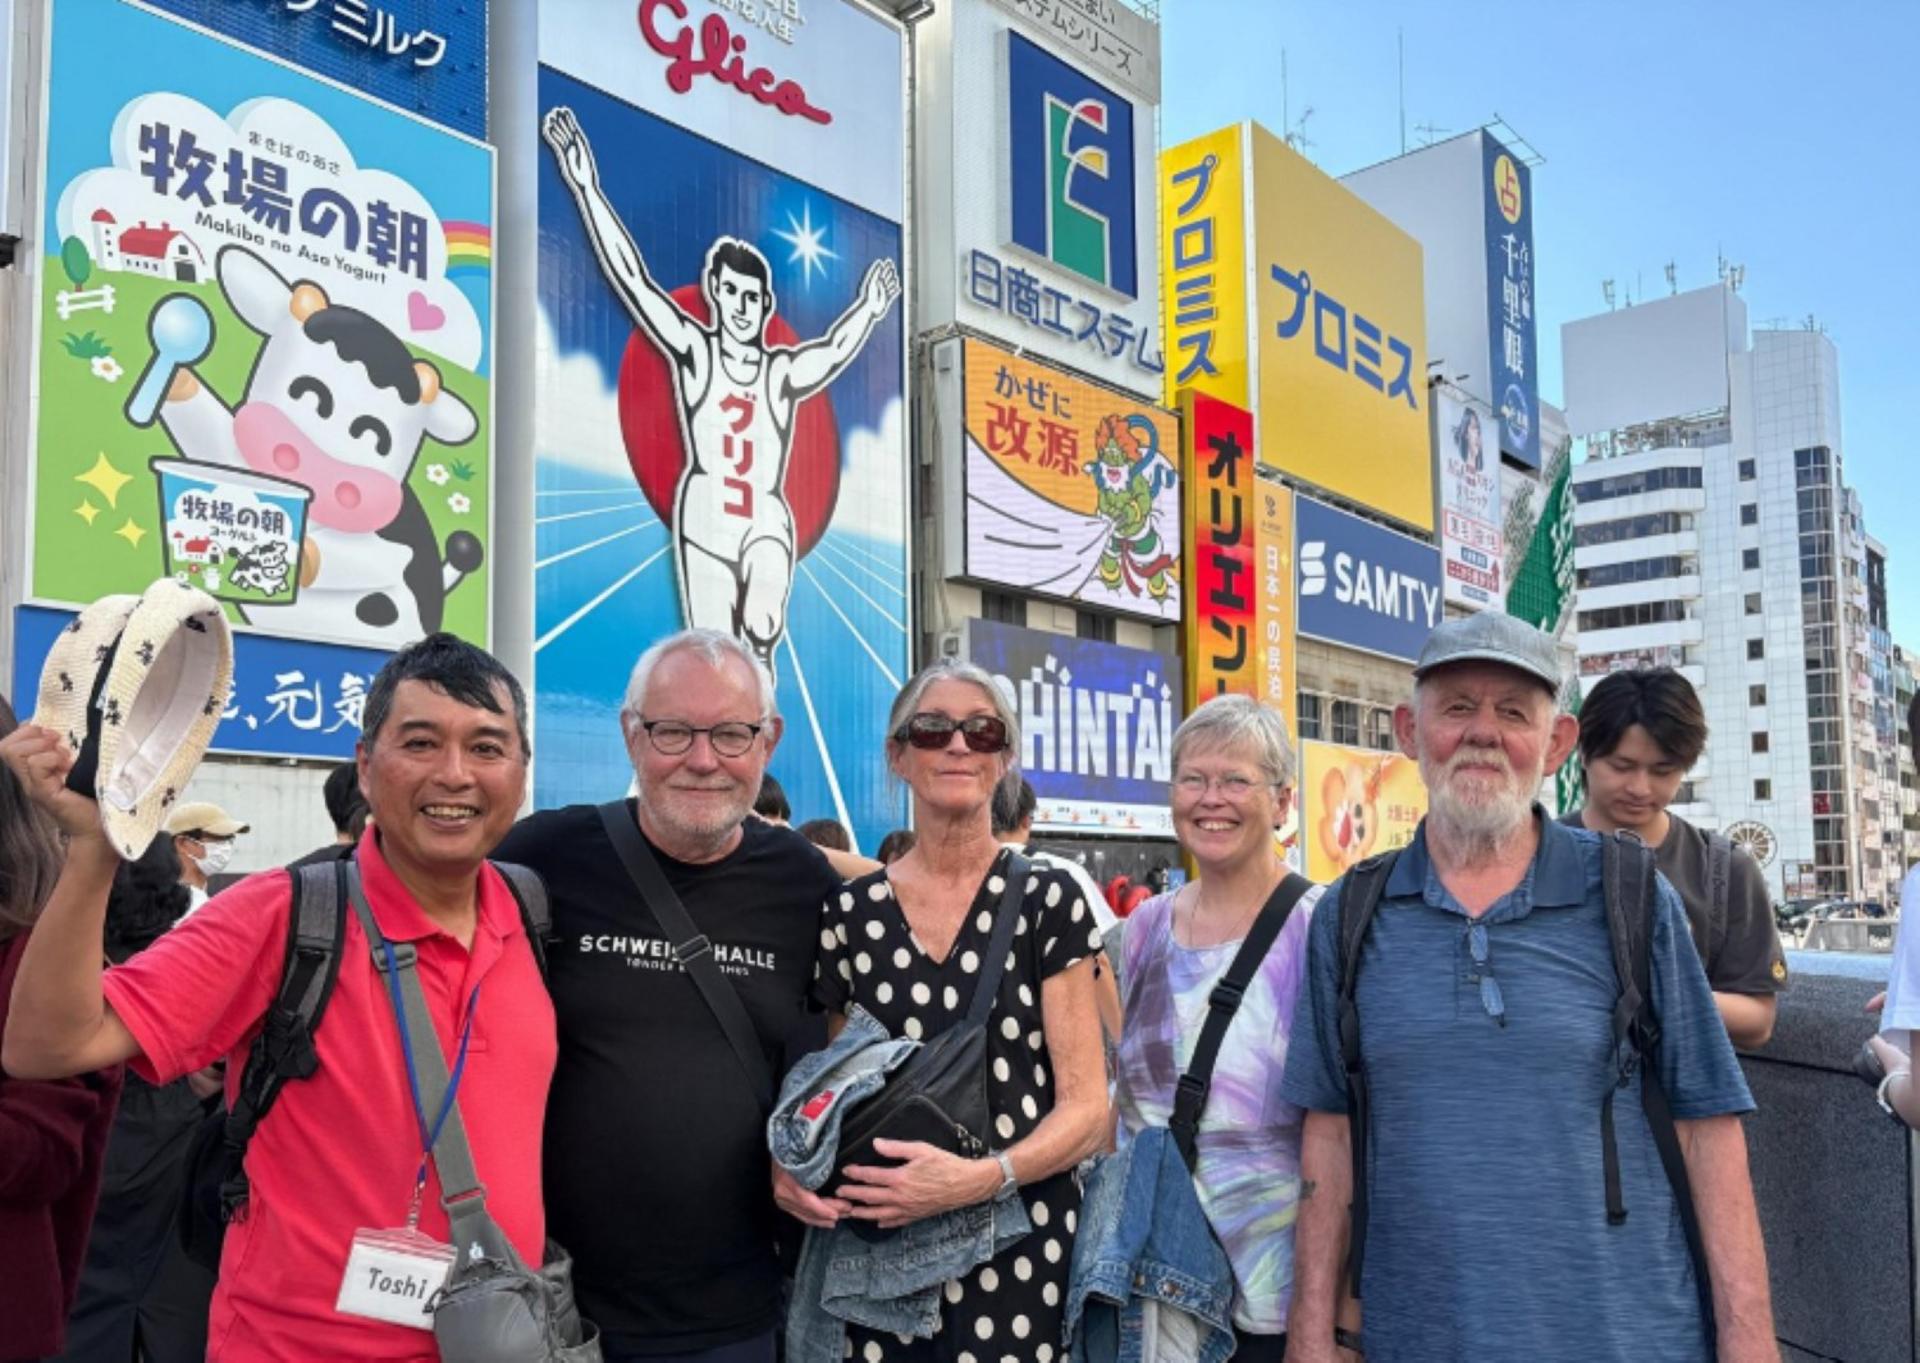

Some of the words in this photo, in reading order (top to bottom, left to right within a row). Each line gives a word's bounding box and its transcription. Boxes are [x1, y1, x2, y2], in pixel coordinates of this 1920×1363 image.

[287, 0, 447, 66] ミルク
[639, 0, 832, 125] Glico
[248, 130, 342, 176] まきばのあさ
[1500, 158, 1517, 218] 占
[138, 122, 428, 281] 牧場の朝
[195, 211, 265, 246] Makiba
[270, 239, 292, 253] no
[297, 245, 331, 266] Asa
[335, 254, 386, 284] Yogurt
[1172, 153, 1218, 385] プロミス
[968, 248, 1164, 373] 日商エステム
[1270, 263, 1418, 410] プロミス
[994, 366, 1072, 420] かぜに
[719, 392, 757, 520] グリコ
[985, 401, 1080, 477] 改源
[183, 494, 285, 536] 牧場の朝
[1207, 431, 1248, 695] オリエン
[1333, 551, 1440, 629] SAMTY
[368, 1267, 428, 1299] Toshi
